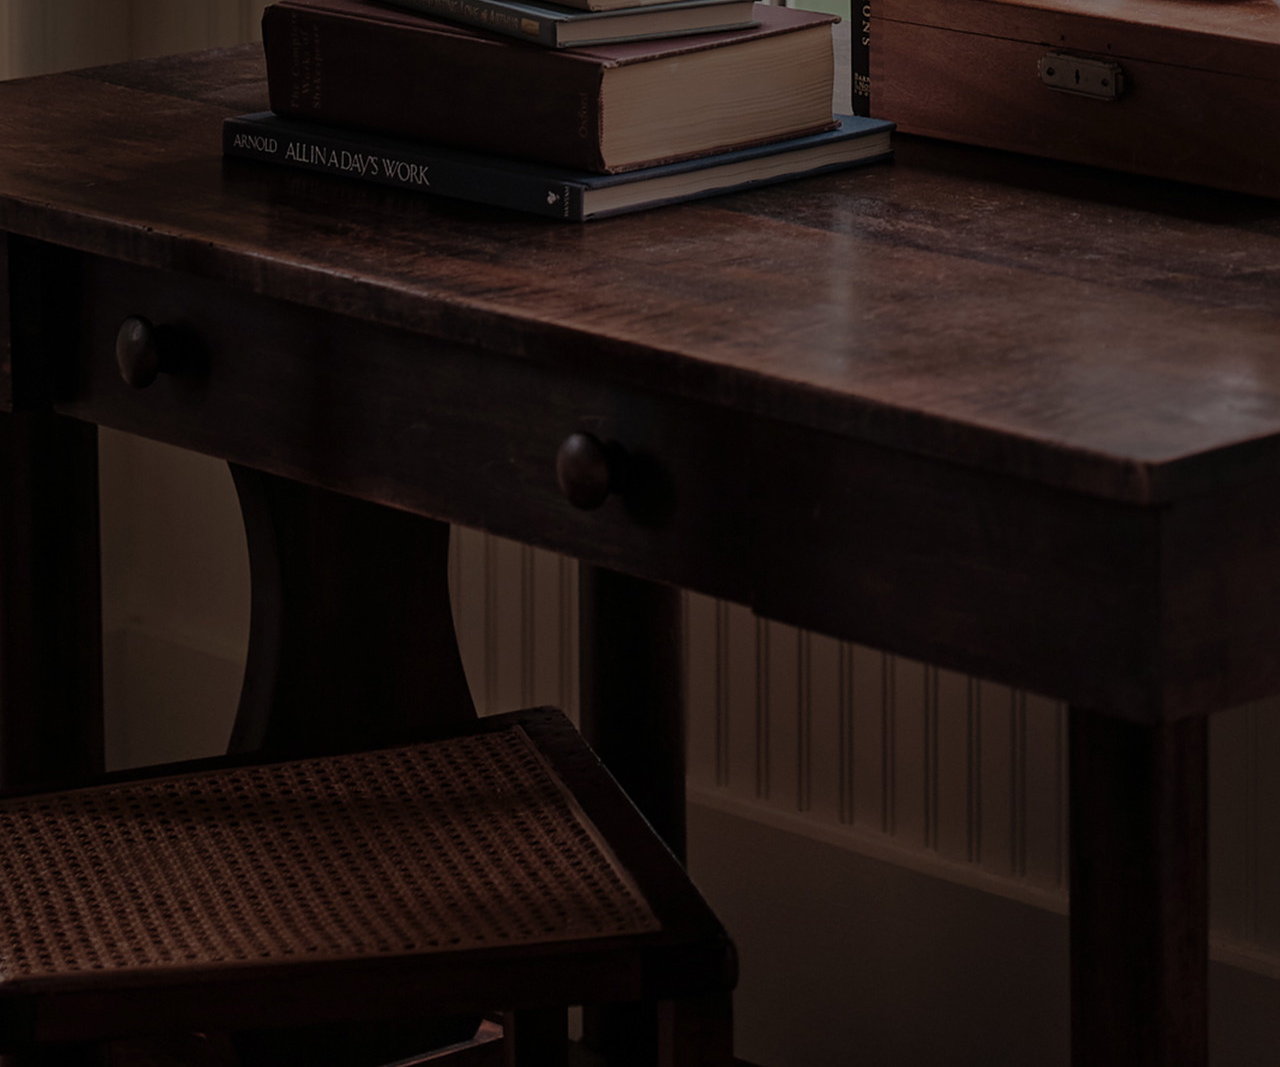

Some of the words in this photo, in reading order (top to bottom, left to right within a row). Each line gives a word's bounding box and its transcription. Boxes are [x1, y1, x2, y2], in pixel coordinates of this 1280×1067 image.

[312, 24, 323, 110] Shakespeare
[233, 134, 278, 153] ARNOLD
[340, 151, 379, 177] DAY'S
[382, 158, 430, 186] WORK
